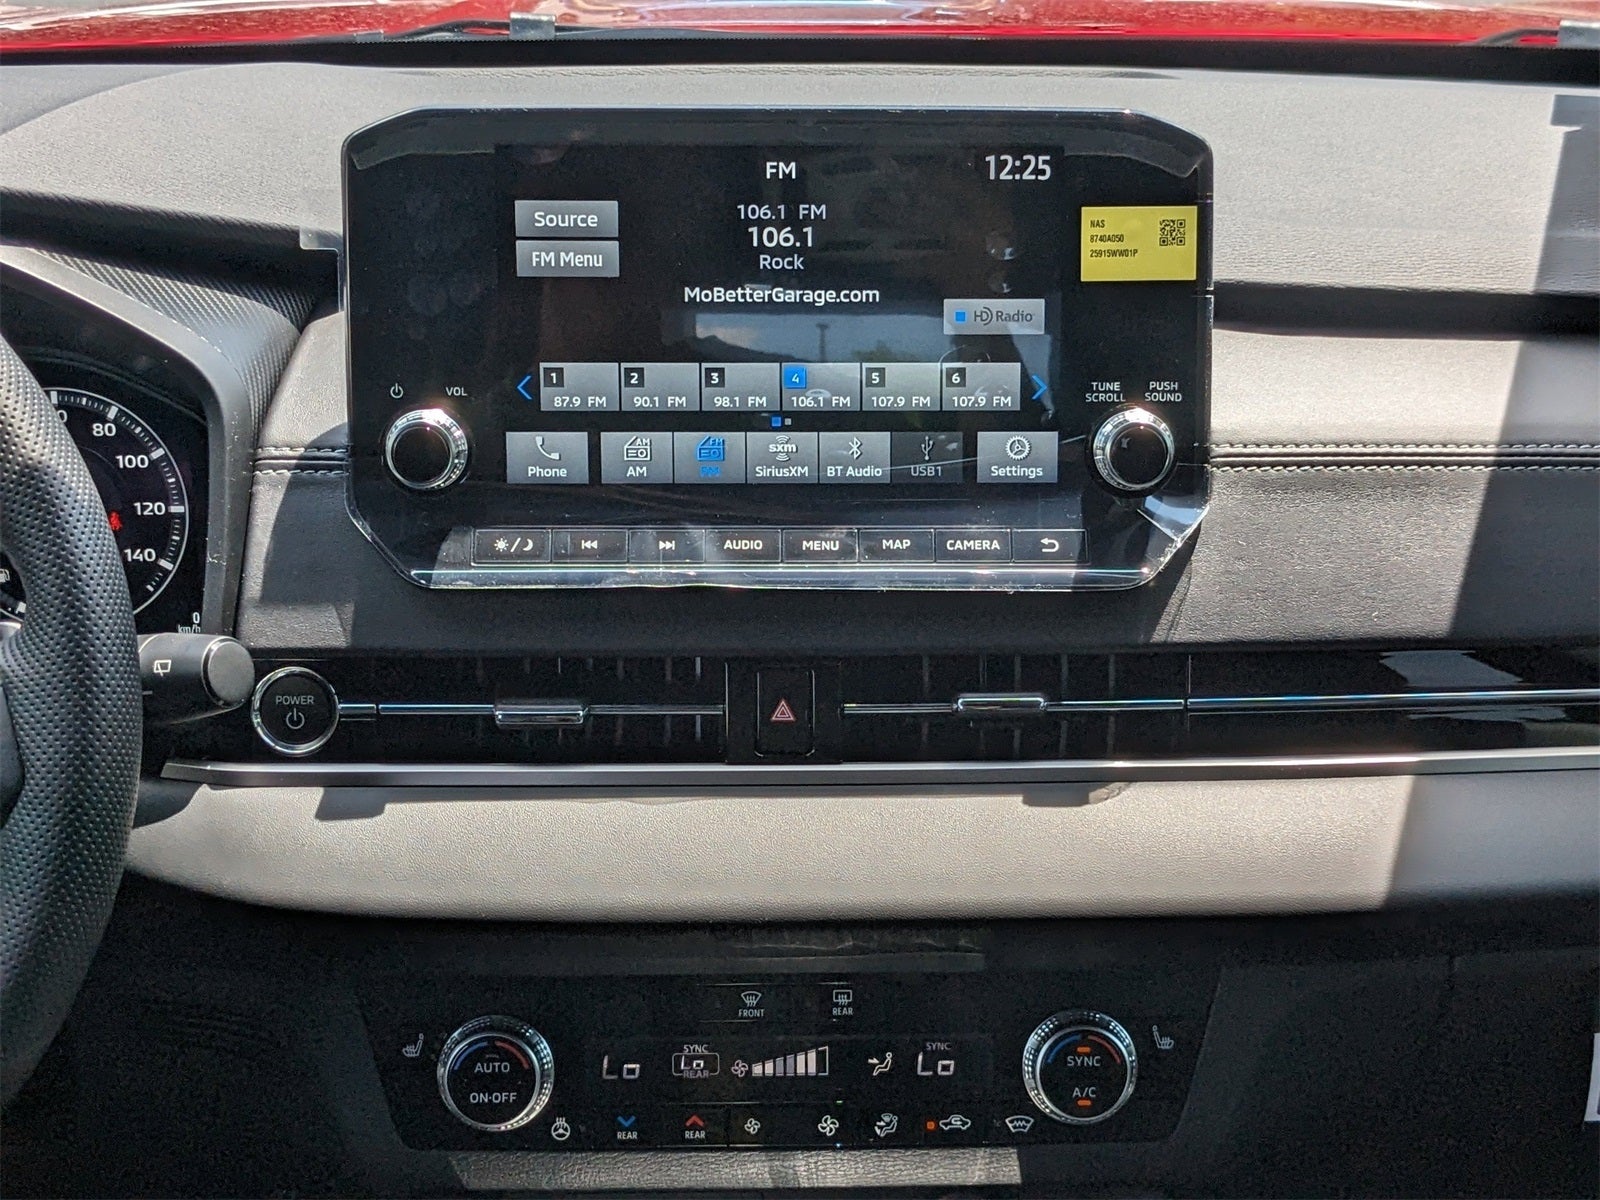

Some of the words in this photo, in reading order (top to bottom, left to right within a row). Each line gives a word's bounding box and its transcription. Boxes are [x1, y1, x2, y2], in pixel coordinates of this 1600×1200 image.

[765, 161, 797, 180] FM
[984, 154, 1052, 181] 12:25
[736, 203, 786, 221] 106.1
[798, 204, 827, 220] FM
[533, 211, 599, 228] Source
[1089, 219, 1106, 229] NAS
[747, 226, 814, 248] 106.1
[531, 251, 556, 267] FM
[559, 251, 603, 267] Menu
[758, 254, 805, 270] Rock
[683, 285, 881, 307] MoBetterGarage.com
[995, 308, 1034, 324] Radio
[549, 372, 558, 384] 1
[629, 372, 639, 384] 2
[710, 372, 720, 384] 3
[791, 372, 801, 383] 4
[870, 372, 881, 384] 5
[951, 372, 961, 384] 6
[445, 386, 468, 397] VOL
[1091, 381, 1121, 392] TUNE
[1148, 381, 1179, 391] PUSH
[553, 396, 581, 408] 87.9
[588, 396, 607, 408] FM
[633, 396, 659, 408] 90.1
[667, 396, 687, 408] FM
[713, 396, 740, 408] 98.1
[748, 396, 767, 408] FM
[791, 396, 825, 408] 106.1
[832, 396, 851, 408] FM
[871, 396, 906, 408] 107.9
[912, 396, 931, 408] FM
[952, 396, 987, 408] 107.9
[993, 396, 1012, 408] FM
[1085, 392, 1126, 403] SCROLL
[1144, 392, 1183, 402] SOUND
[92, 423, 117, 437] 80
[769, 444, 797, 453] sxm
[116, 454, 149, 469] 100
[527, 465, 568, 478] Phone
[626, 466, 647, 478] AM
[755, 466, 809, 477] SiriusXM
[827, 466, 843, 477] BT
[846, 466, 883, 477] Audio
[911, 466, 942, 477] USB1
[991, 465, 1043, 480] Settings
[133, 501, 166, 516] 120
[723, 539, 763, 550] AUDIO
[802, 540, 839, 551] MENU
[882, 539, 911, 550] MAP
[946, 539, 1000, 551] CAMERA
[124, 548, 156, 562] 140
[192, 612, 200, 624] 0
[177, 624, 201, 634] km/h
[275, 695, 314, 705] POWER
[738, 1008, 765, 1017] FRONT
[832, 1007, 853, 1016] REAR
[683, 1045, 709, 1053] SYNC
[925, 1041, 951, 1051] SYNC
[1066, 1055, 1101, 1067] SYNC
[474, 1062, 510, 1073] AUTO
[683, 1070, 709, 1079] REAR
[1072, 1087, 1096, 1099] A/C
[617, 1131, 637, 1140] REAR
[685, 1130, 705, 1139] REAR
